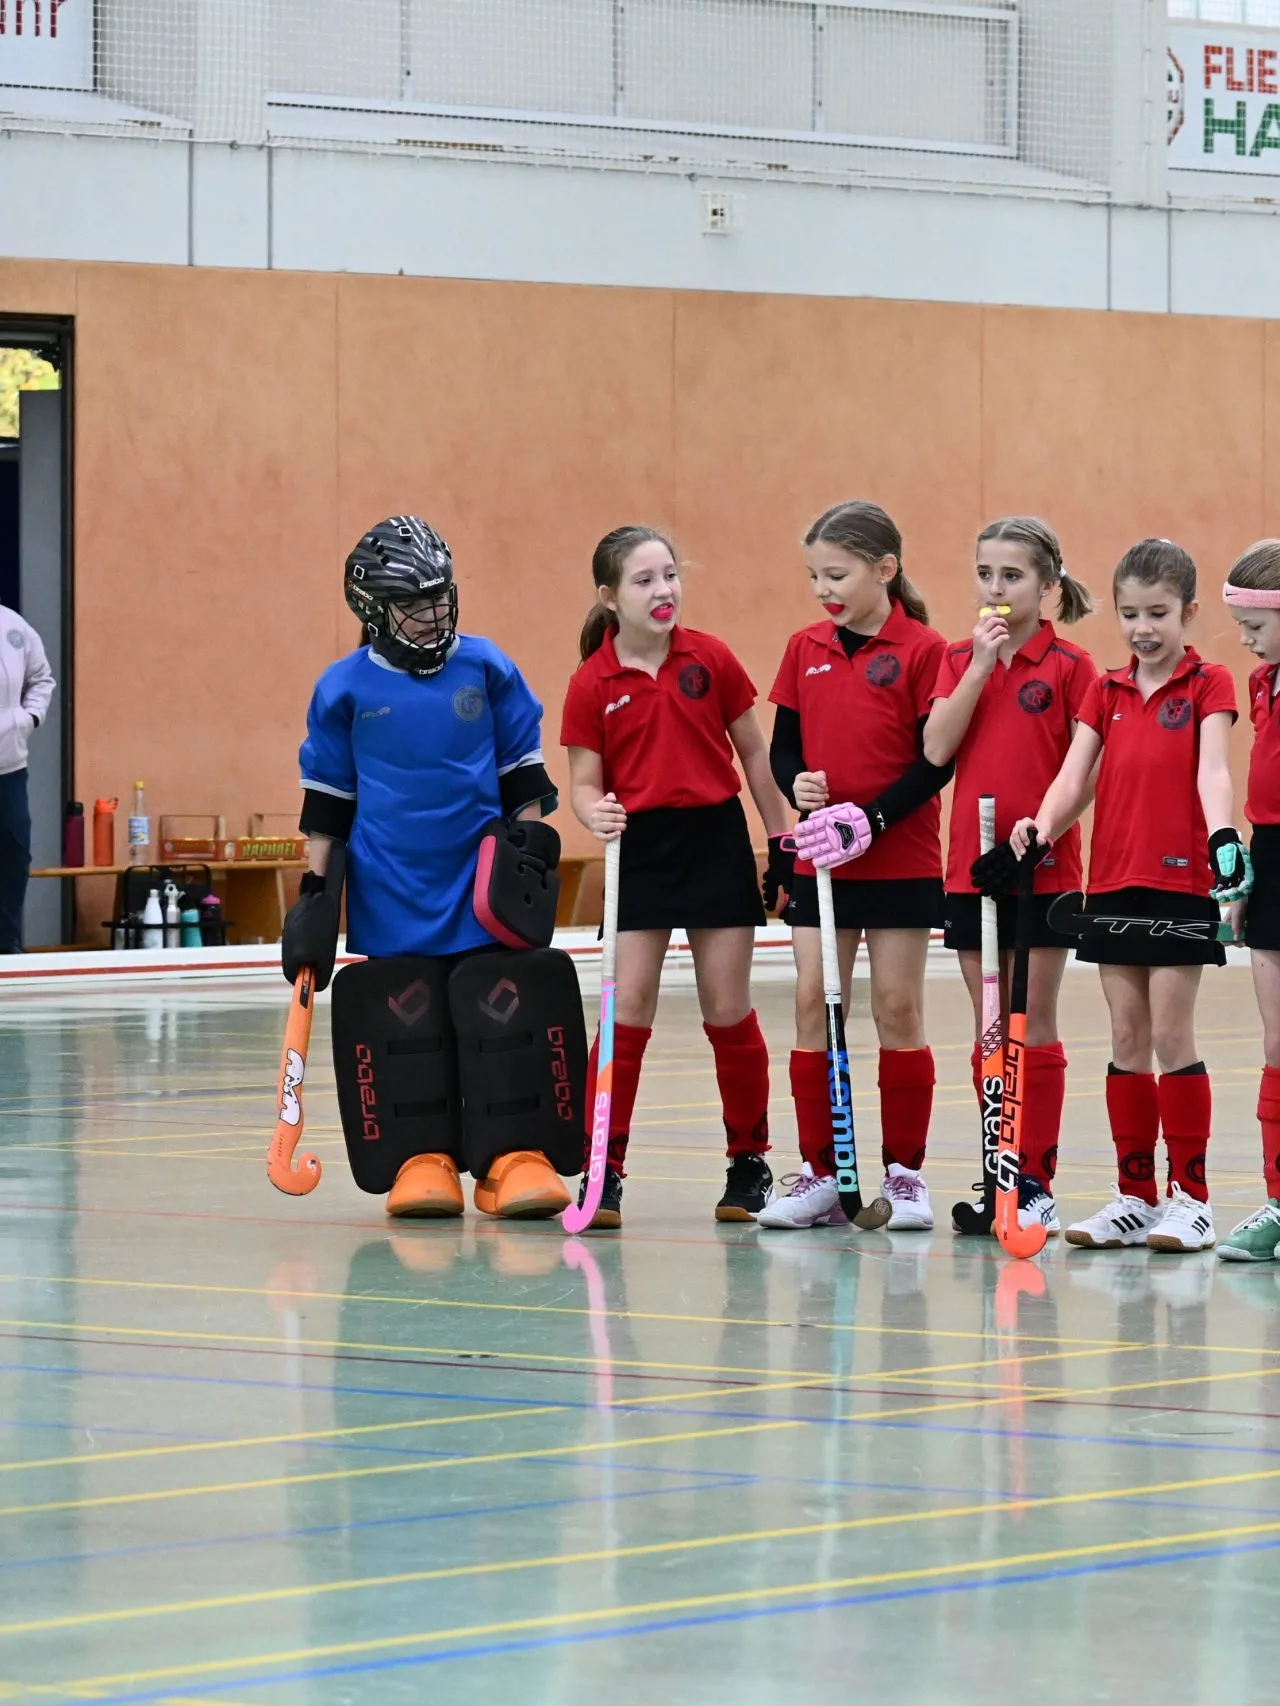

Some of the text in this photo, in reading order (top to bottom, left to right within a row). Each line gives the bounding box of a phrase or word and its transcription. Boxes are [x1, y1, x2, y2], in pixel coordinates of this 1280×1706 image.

[1094, 917, 1211, 940] TK
[356, 1044, 380, 1140] brabo
[547, 1026, 573, 1121] brabo
[827, 1050, 858, 1192] Kempa
